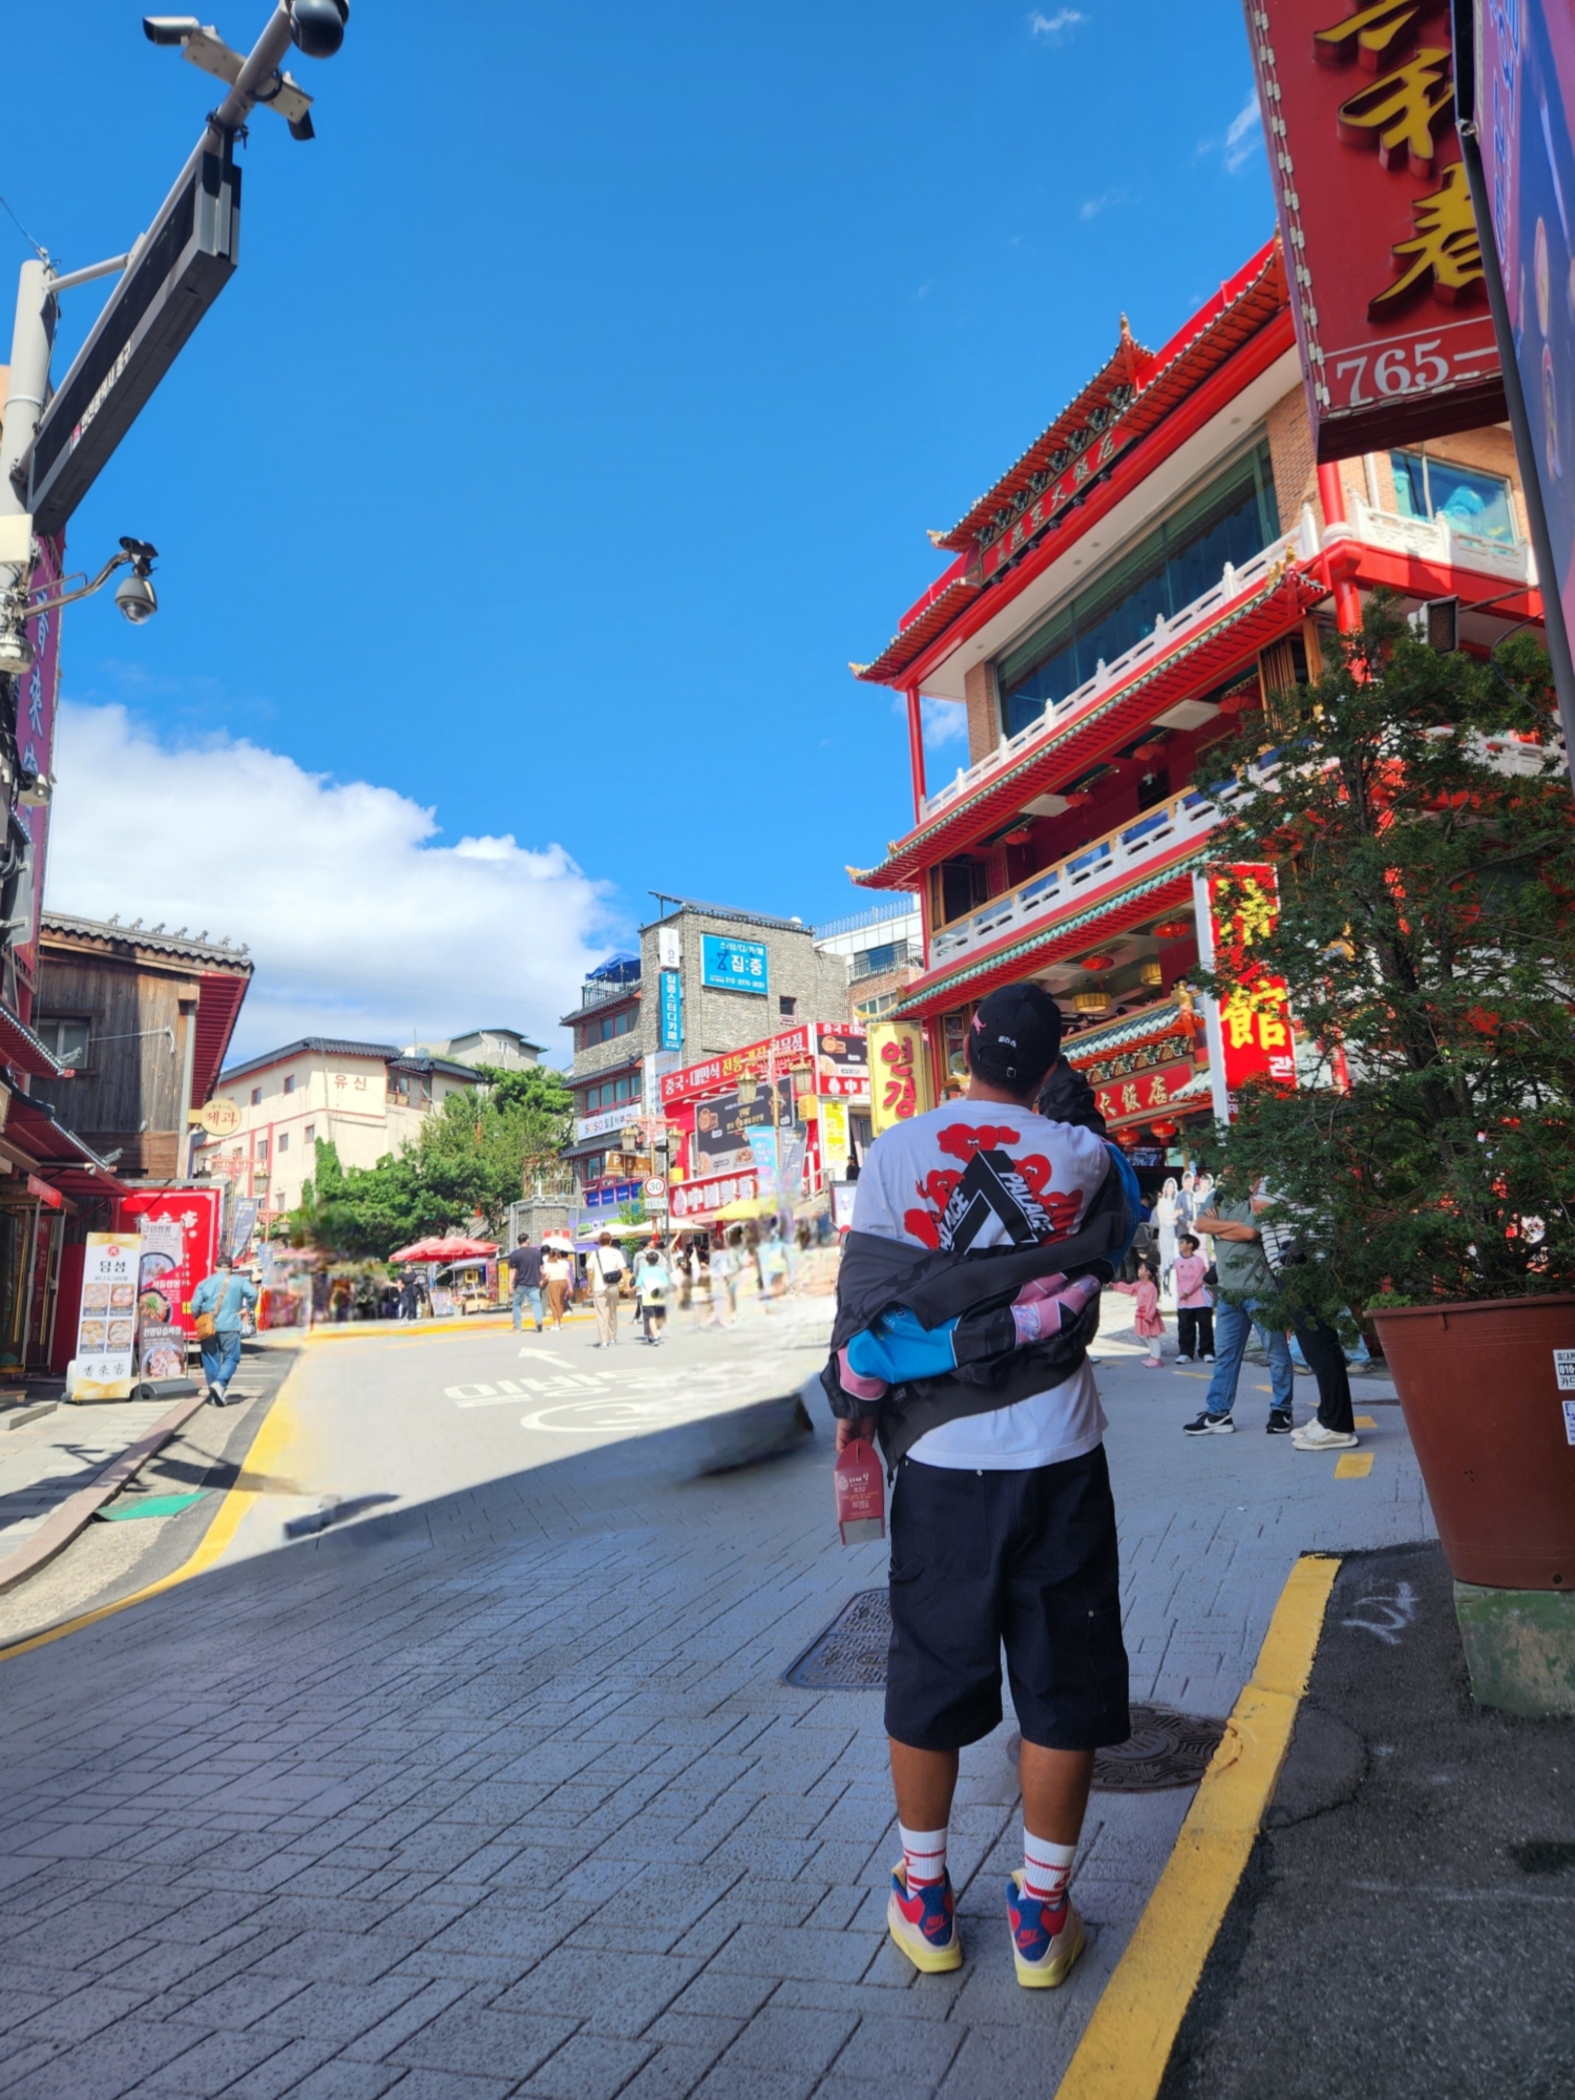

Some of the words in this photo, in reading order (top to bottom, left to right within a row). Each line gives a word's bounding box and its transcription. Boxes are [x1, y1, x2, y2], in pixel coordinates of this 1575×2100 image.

[881, 1036, 917, 1118] 연경
[649, 1181, 662, 1191] 30
[998, 1172, 1055, 1232] PALACE
[940, 1186, 970, 1251] ALACE
[100, 1261, 126, 1273] 딤섬
[926, 1914, 945, 1926] NIKE
[1020, 1929, 1039, 1940] NIKE
